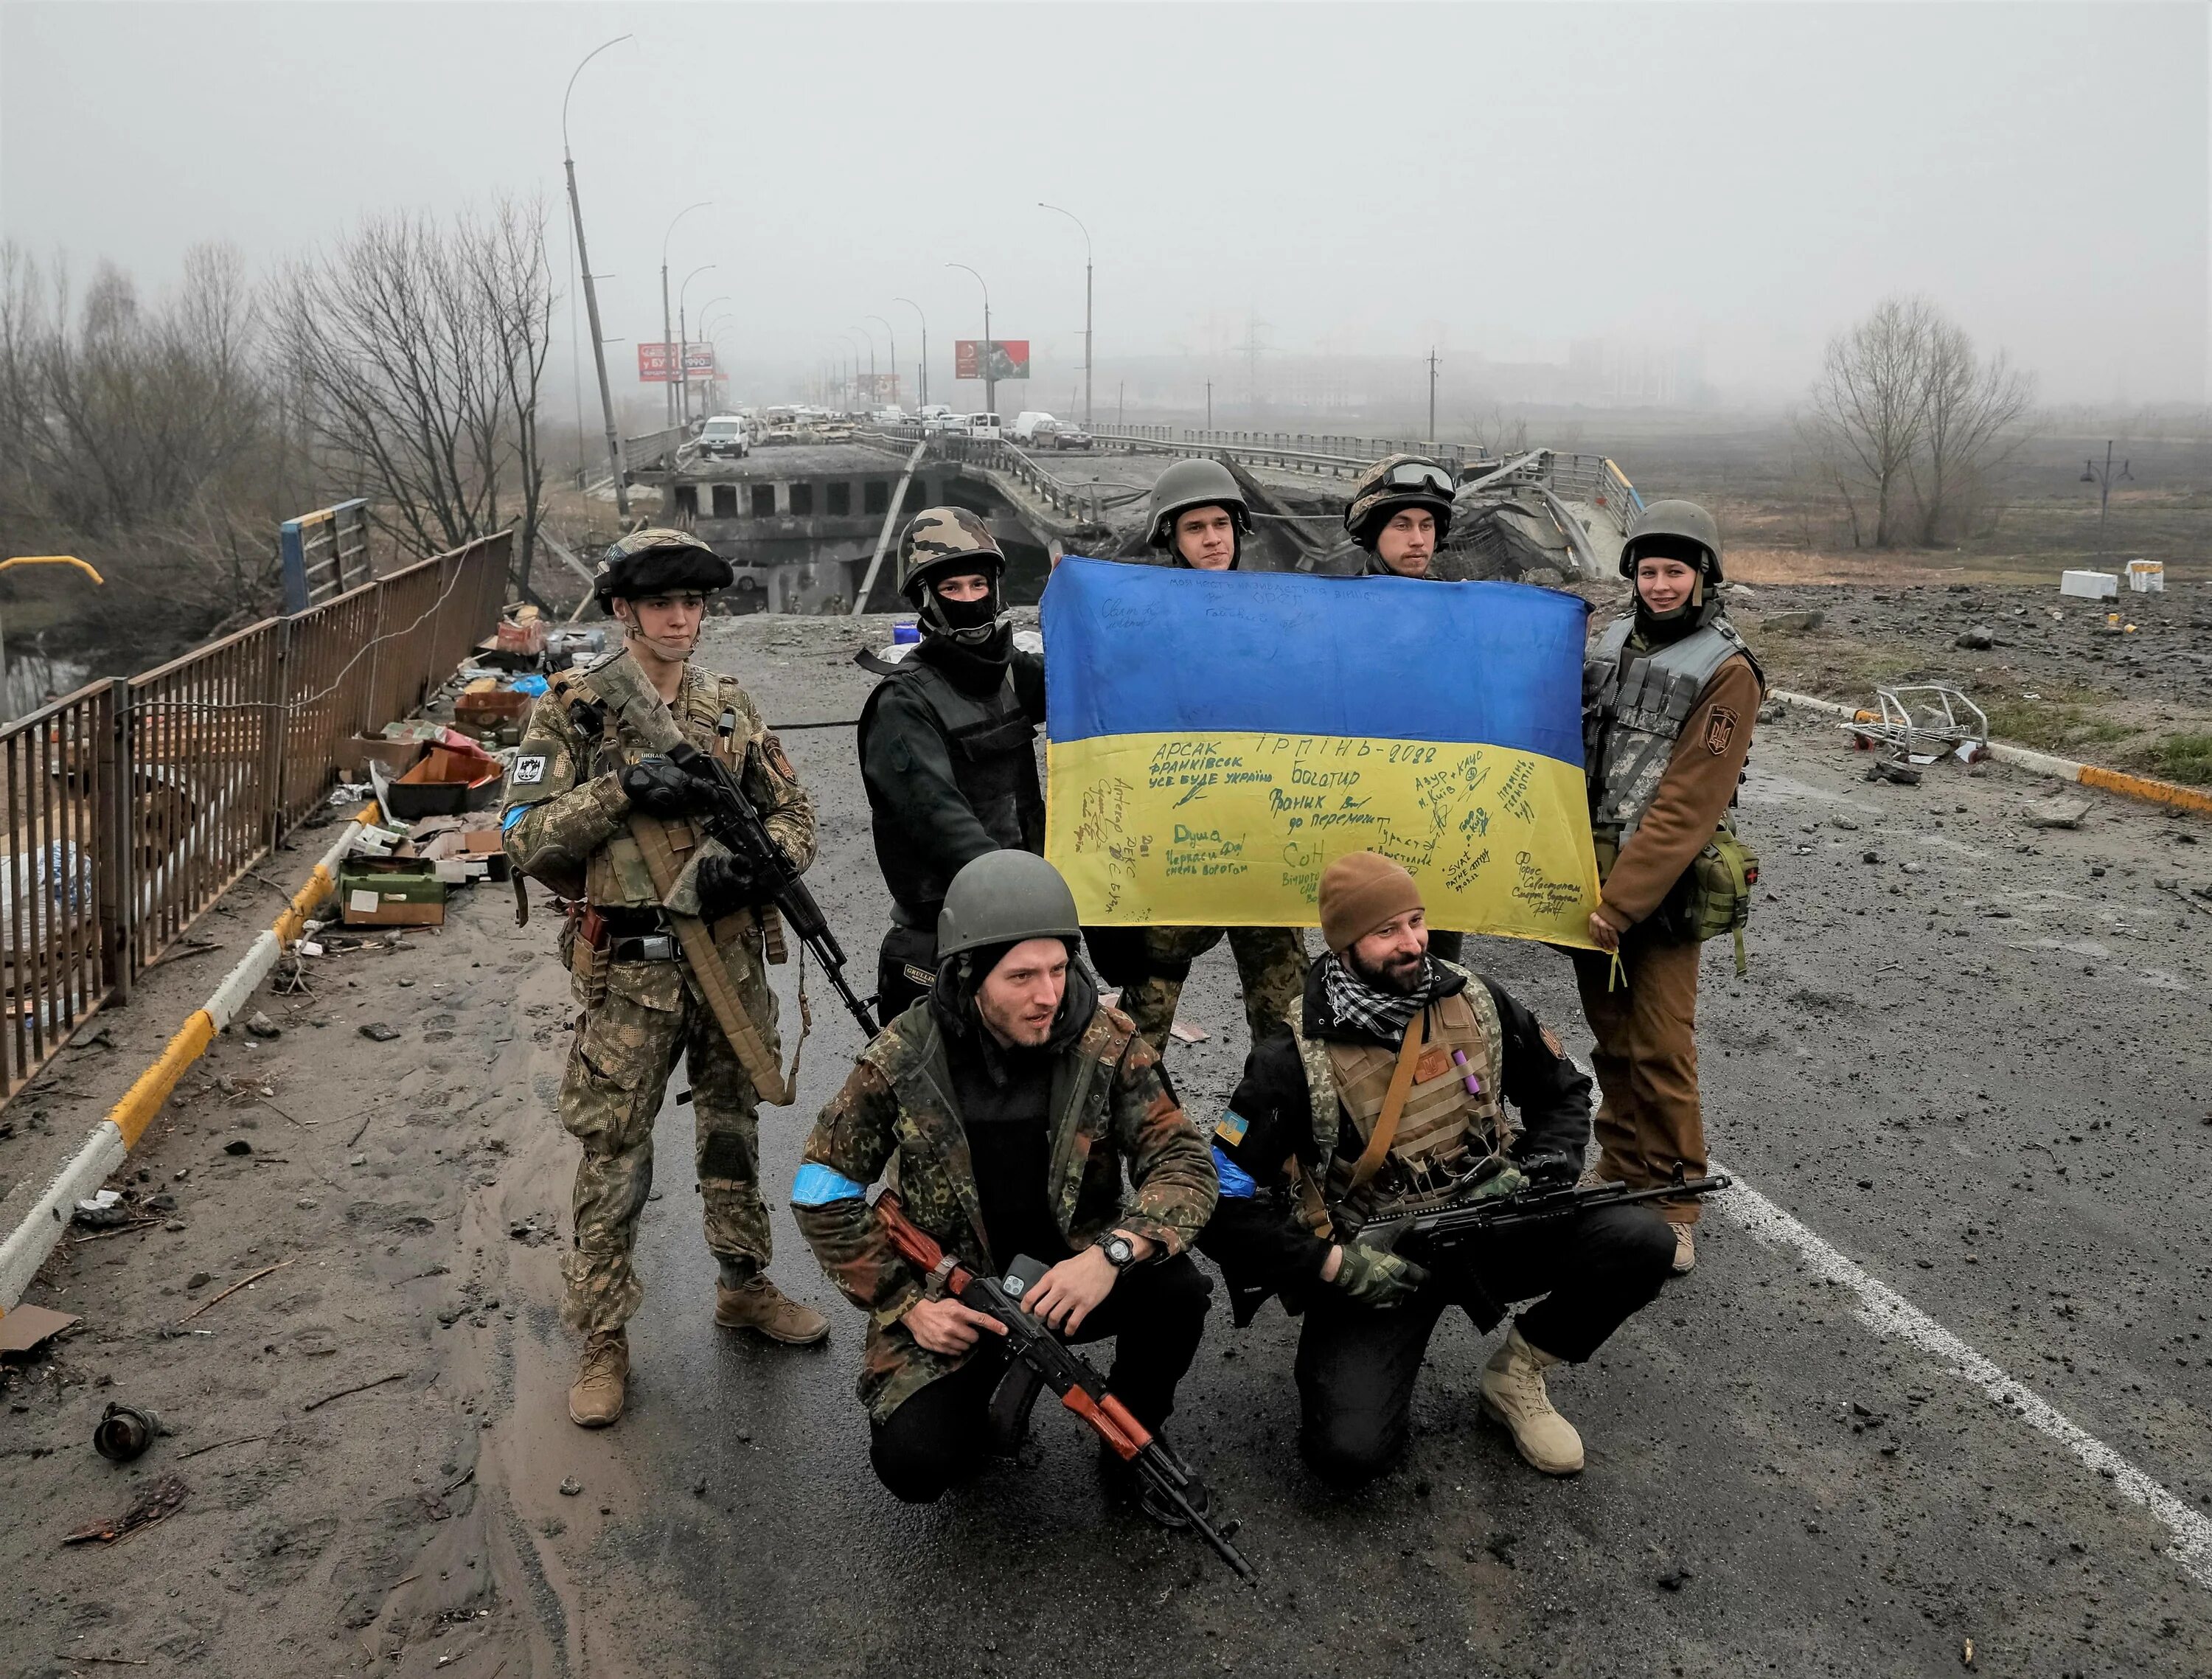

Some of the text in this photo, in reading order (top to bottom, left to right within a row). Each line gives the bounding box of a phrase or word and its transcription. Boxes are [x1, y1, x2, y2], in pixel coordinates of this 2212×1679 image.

[1152, 741, 1221, 762] АРСАК
[1180, 773, 1218, 785] БУДЕ
[1292, 760, 1360, 795] Богатир
